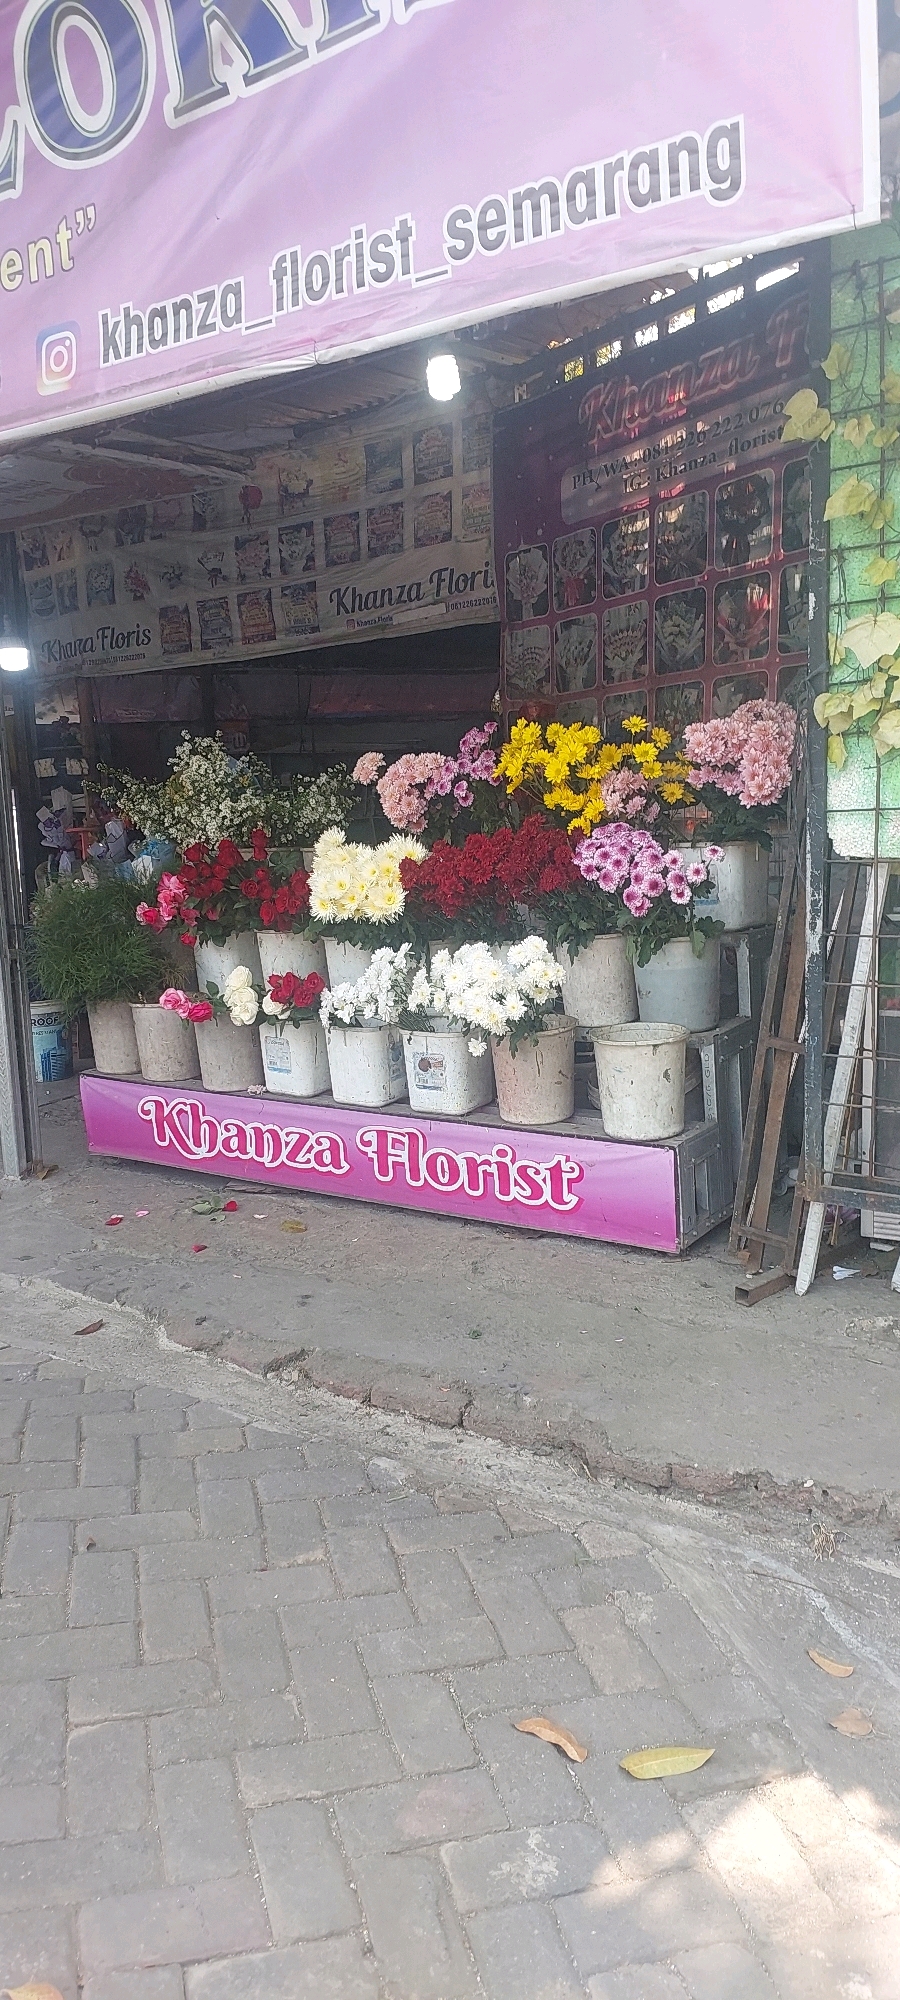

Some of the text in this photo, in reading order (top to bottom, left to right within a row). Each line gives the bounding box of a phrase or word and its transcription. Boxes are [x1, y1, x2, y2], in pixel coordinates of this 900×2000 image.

[99, 118, 744, 367] khanza_florist_semarang
[579, 333, 760, 448] Khanza
[712, 413, 743, 438] 222
[749, 399, 784, 424] 076
[330, 561, 494, 616] Khanza Flori
[97, 623, 152, 651] Floris
[138, 1095, 584, 1213] Khanza Florist
